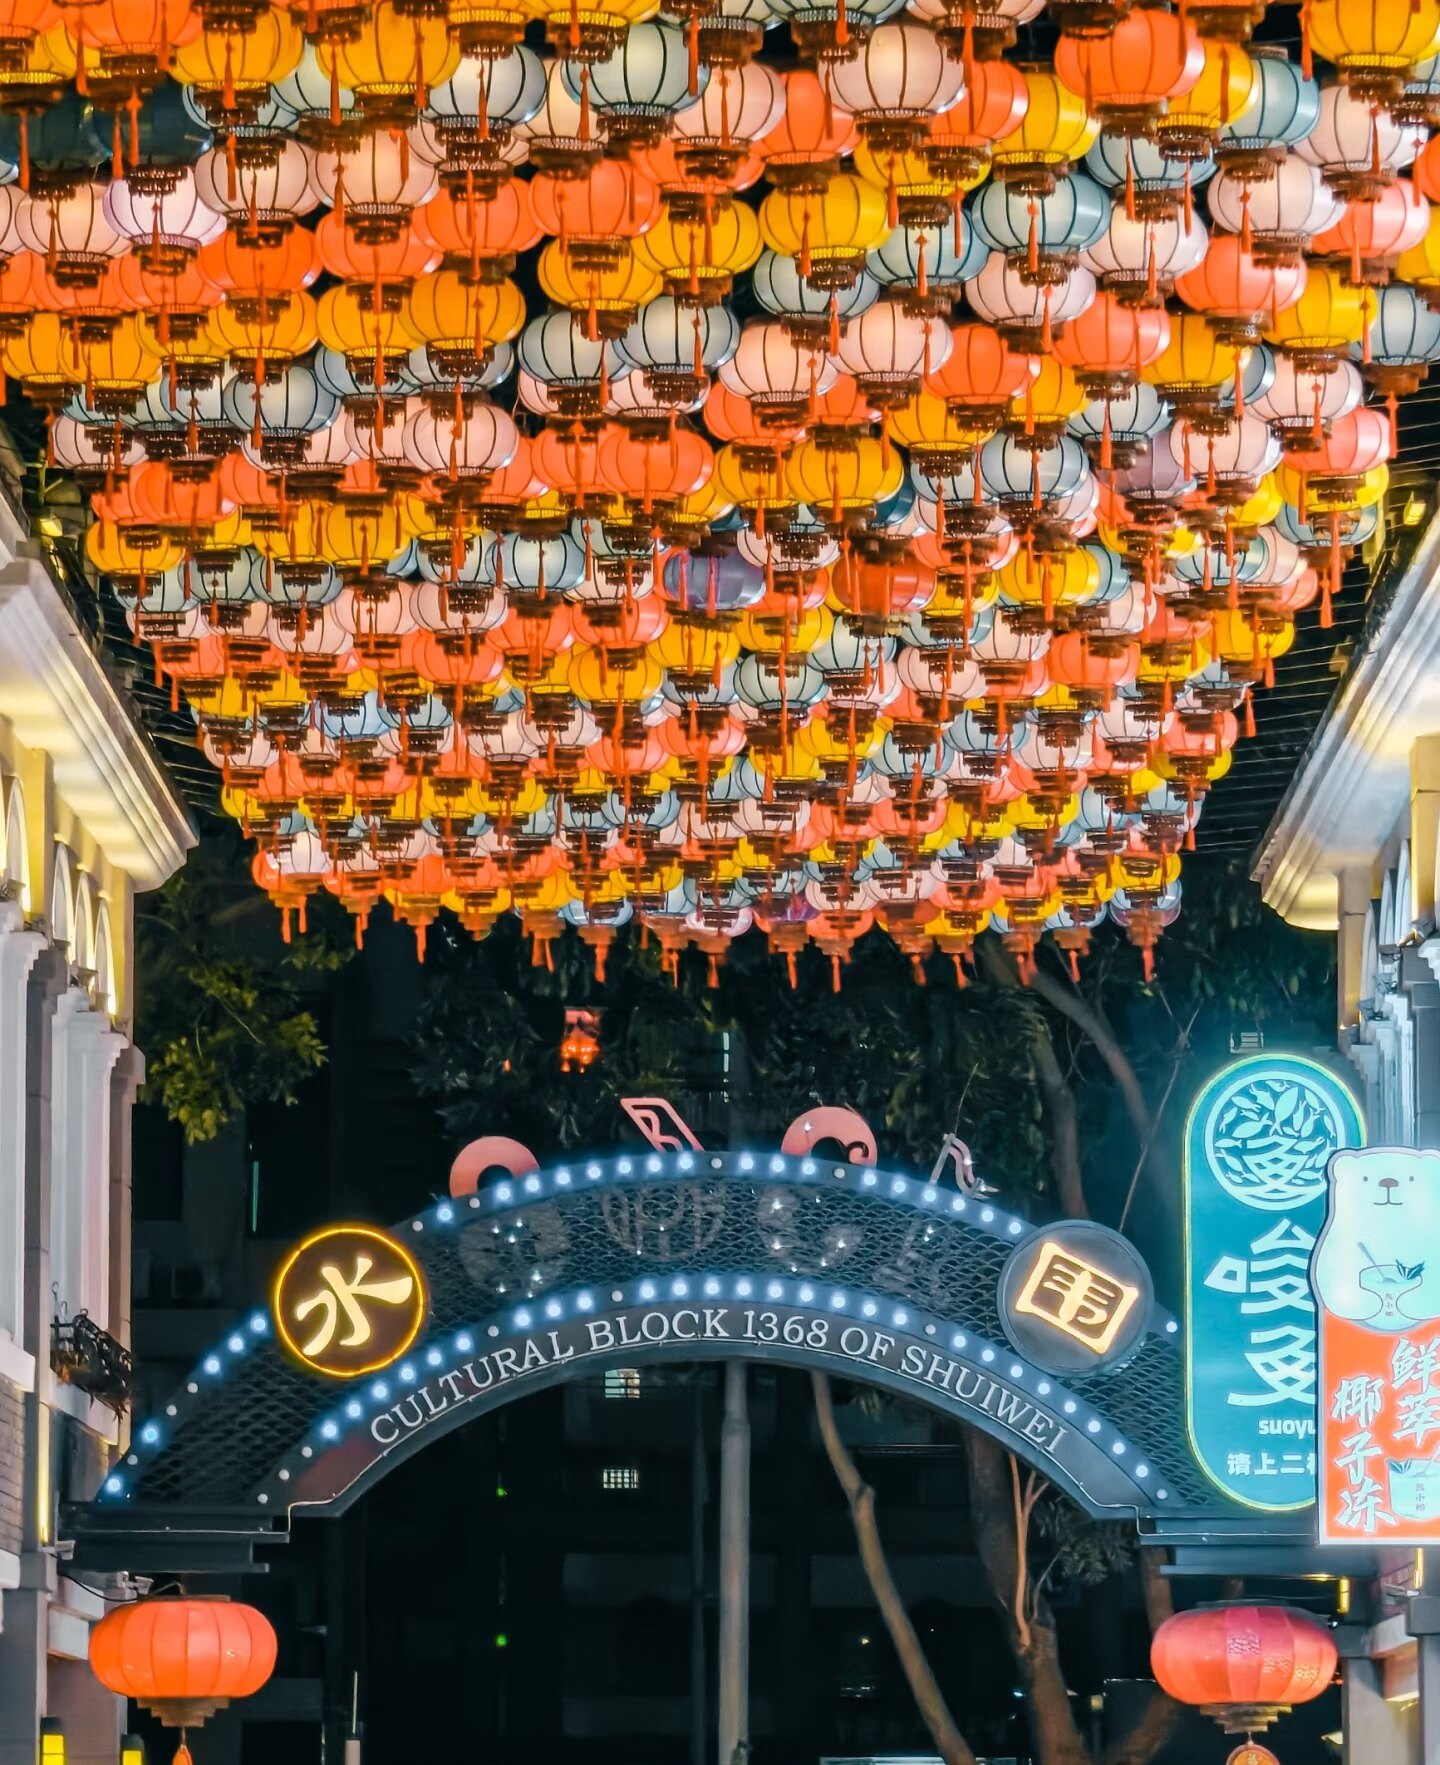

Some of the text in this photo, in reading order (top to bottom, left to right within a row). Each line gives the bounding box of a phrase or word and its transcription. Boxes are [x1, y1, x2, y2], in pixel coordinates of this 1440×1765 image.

[297, 1257, 413, 1356] 水
[1015, 1242, 1139, 1354] 围
[371, 1308, 1069, 1456] CULTURAL BLOCK 1368 OF SHUIWEI
[1331, 1375, 1397, 1533] 椰子冻
